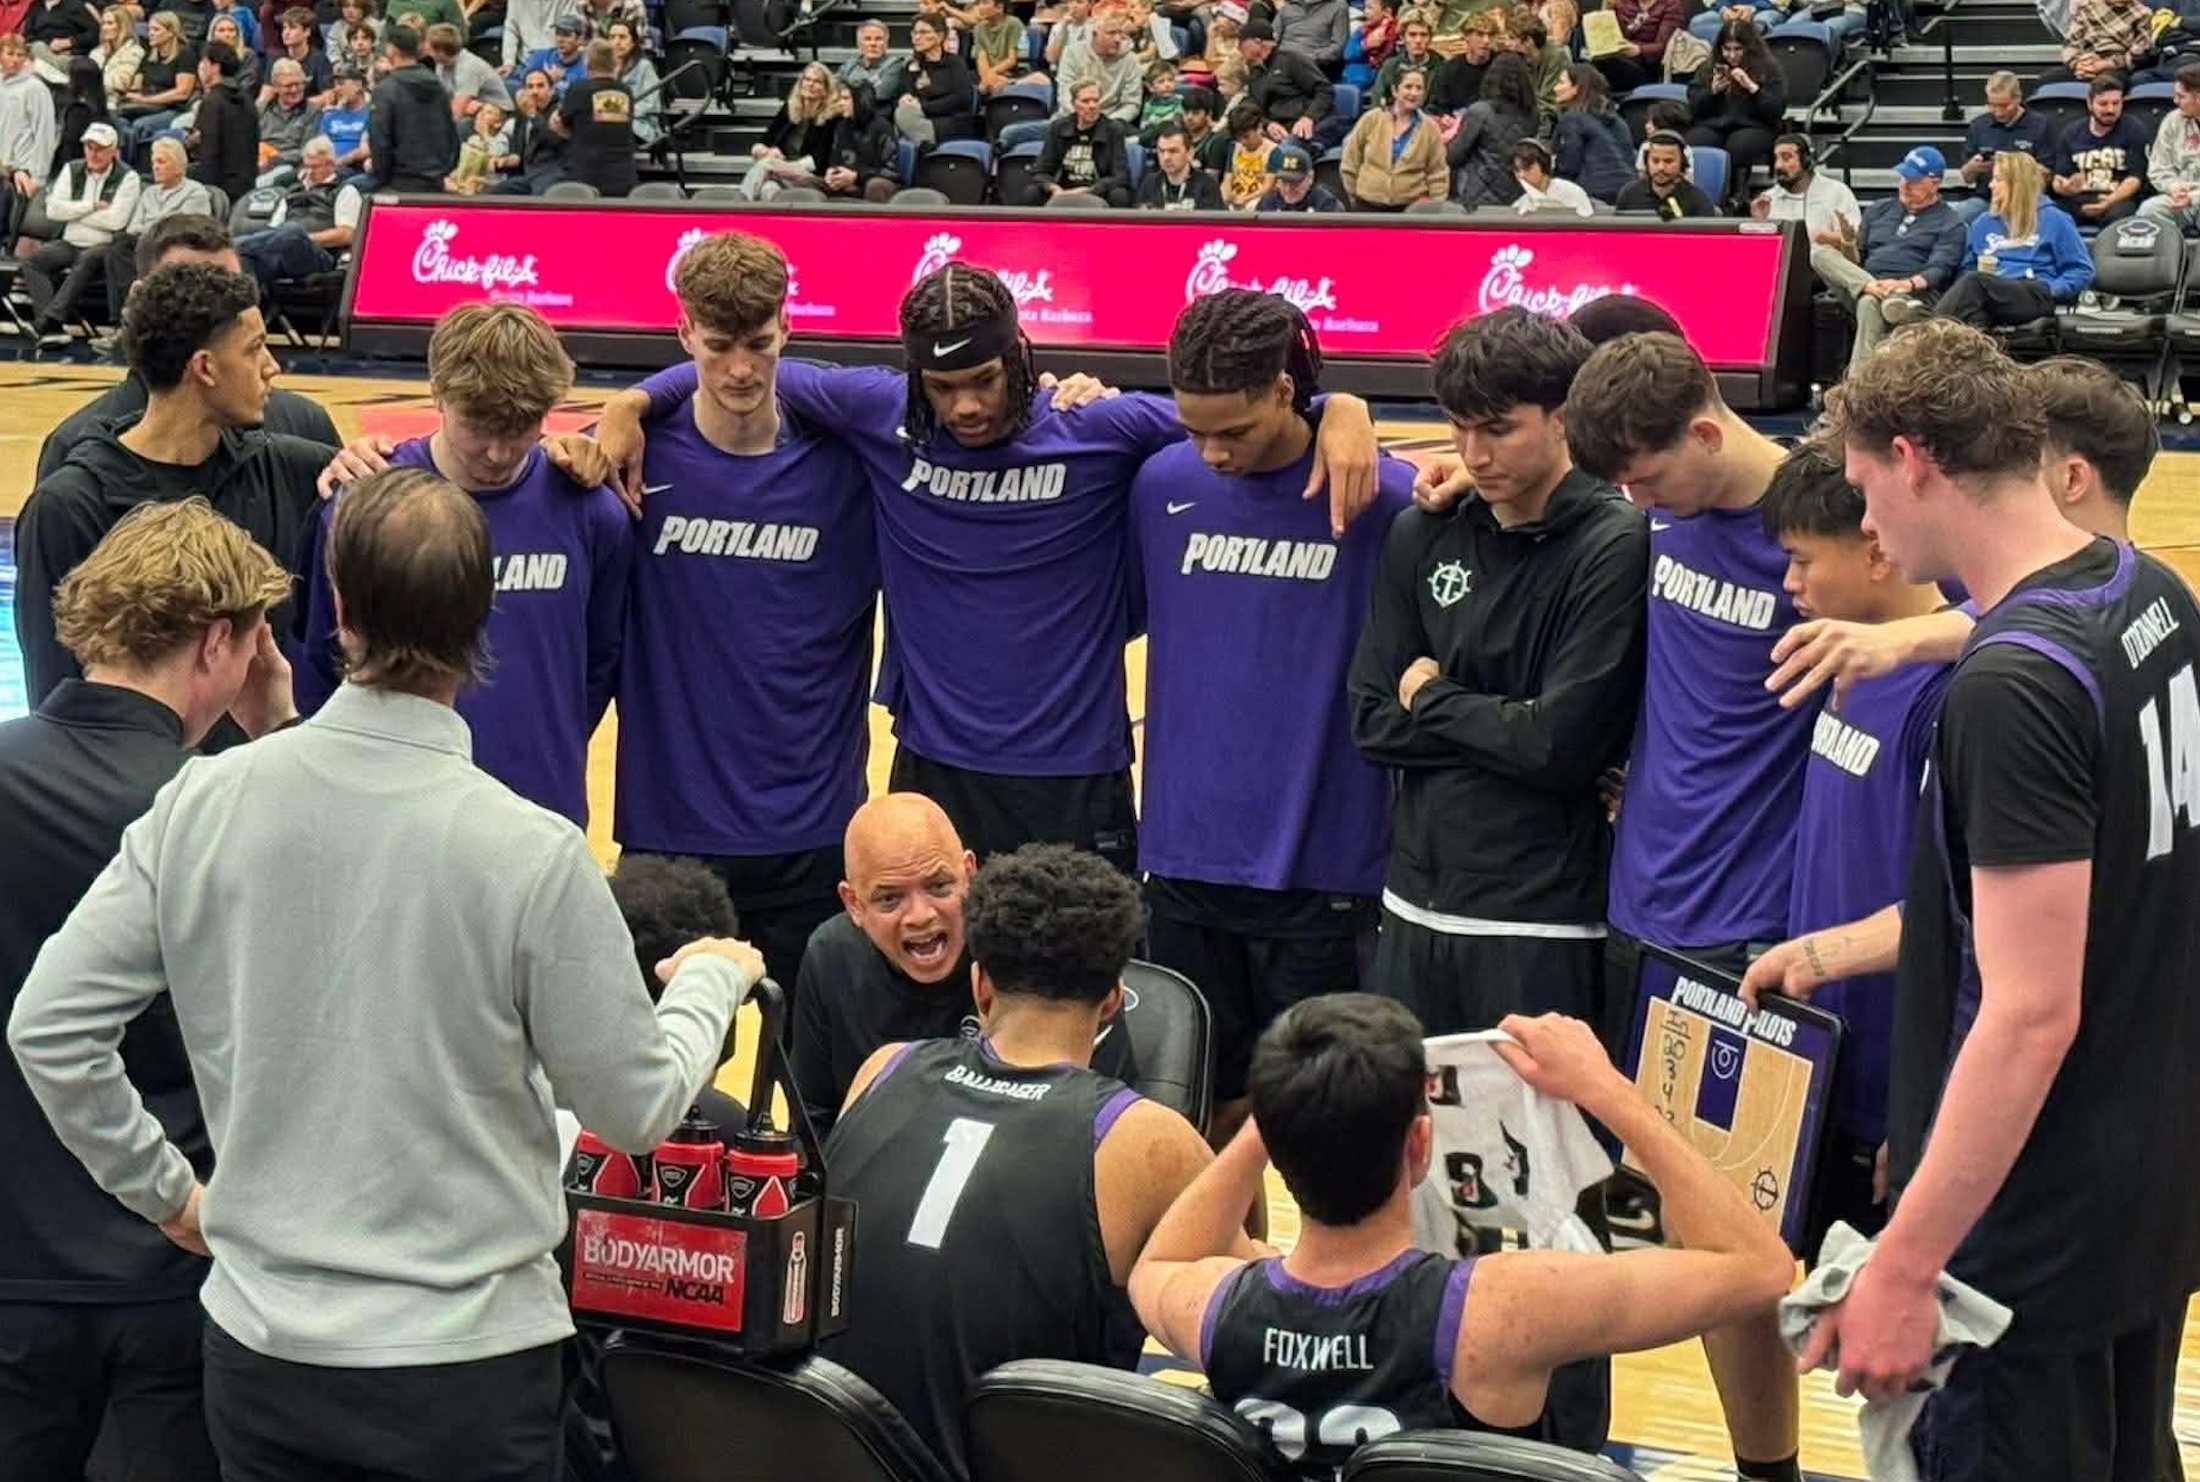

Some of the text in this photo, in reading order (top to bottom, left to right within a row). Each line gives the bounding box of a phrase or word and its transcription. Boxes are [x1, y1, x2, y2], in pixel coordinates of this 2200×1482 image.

[412, 220, 538, 290] Chick-fil-A
[901, 456, 1067, 502] PORTLAND
[652, 515, 820, 561] PORTLAND
[1181, 532, 1338, 580] PORTLAND
[492, 553, 568, 591] LAND
[1652, 554, 1777, 630] PORTLAND
[2139, 662, 2200, 861] 14
[1670, 975, 1748, 1026] PORTLAND
[907, 1117, 996, 1251] 1
[584, 1235, 735, 1284] BODYARMOR
[831, 1226, 844, 1318] BODYARMOR
[663, 1277, 726, 1306] NCAA
[1263, 1326, 1375, 1371] FOXWELL
